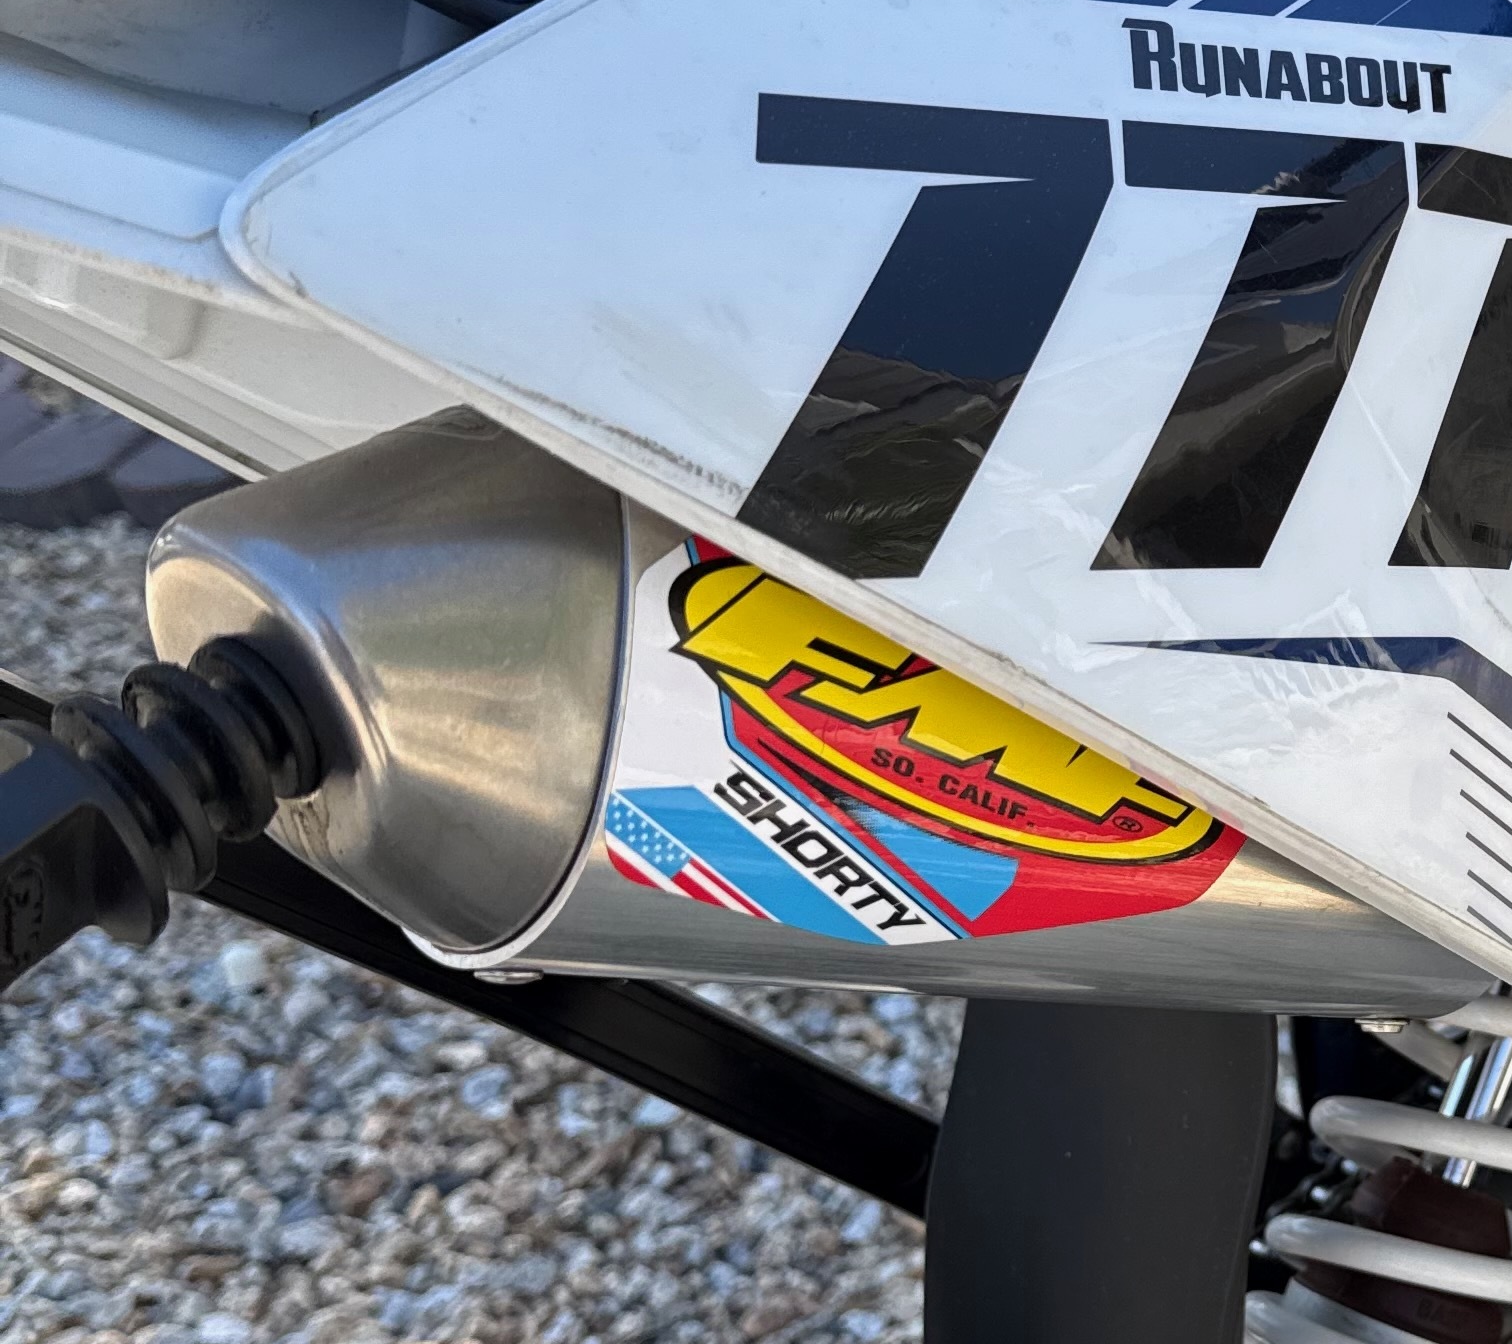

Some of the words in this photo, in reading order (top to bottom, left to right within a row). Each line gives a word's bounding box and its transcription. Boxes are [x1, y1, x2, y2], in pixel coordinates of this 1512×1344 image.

[1122, 17, 1452, 114] RUNABOUT
[871, 747, 925, 784] SO.
[938, 773, 1036, 828] CALIF.
[713, 759, 927, 931] SHORTY
